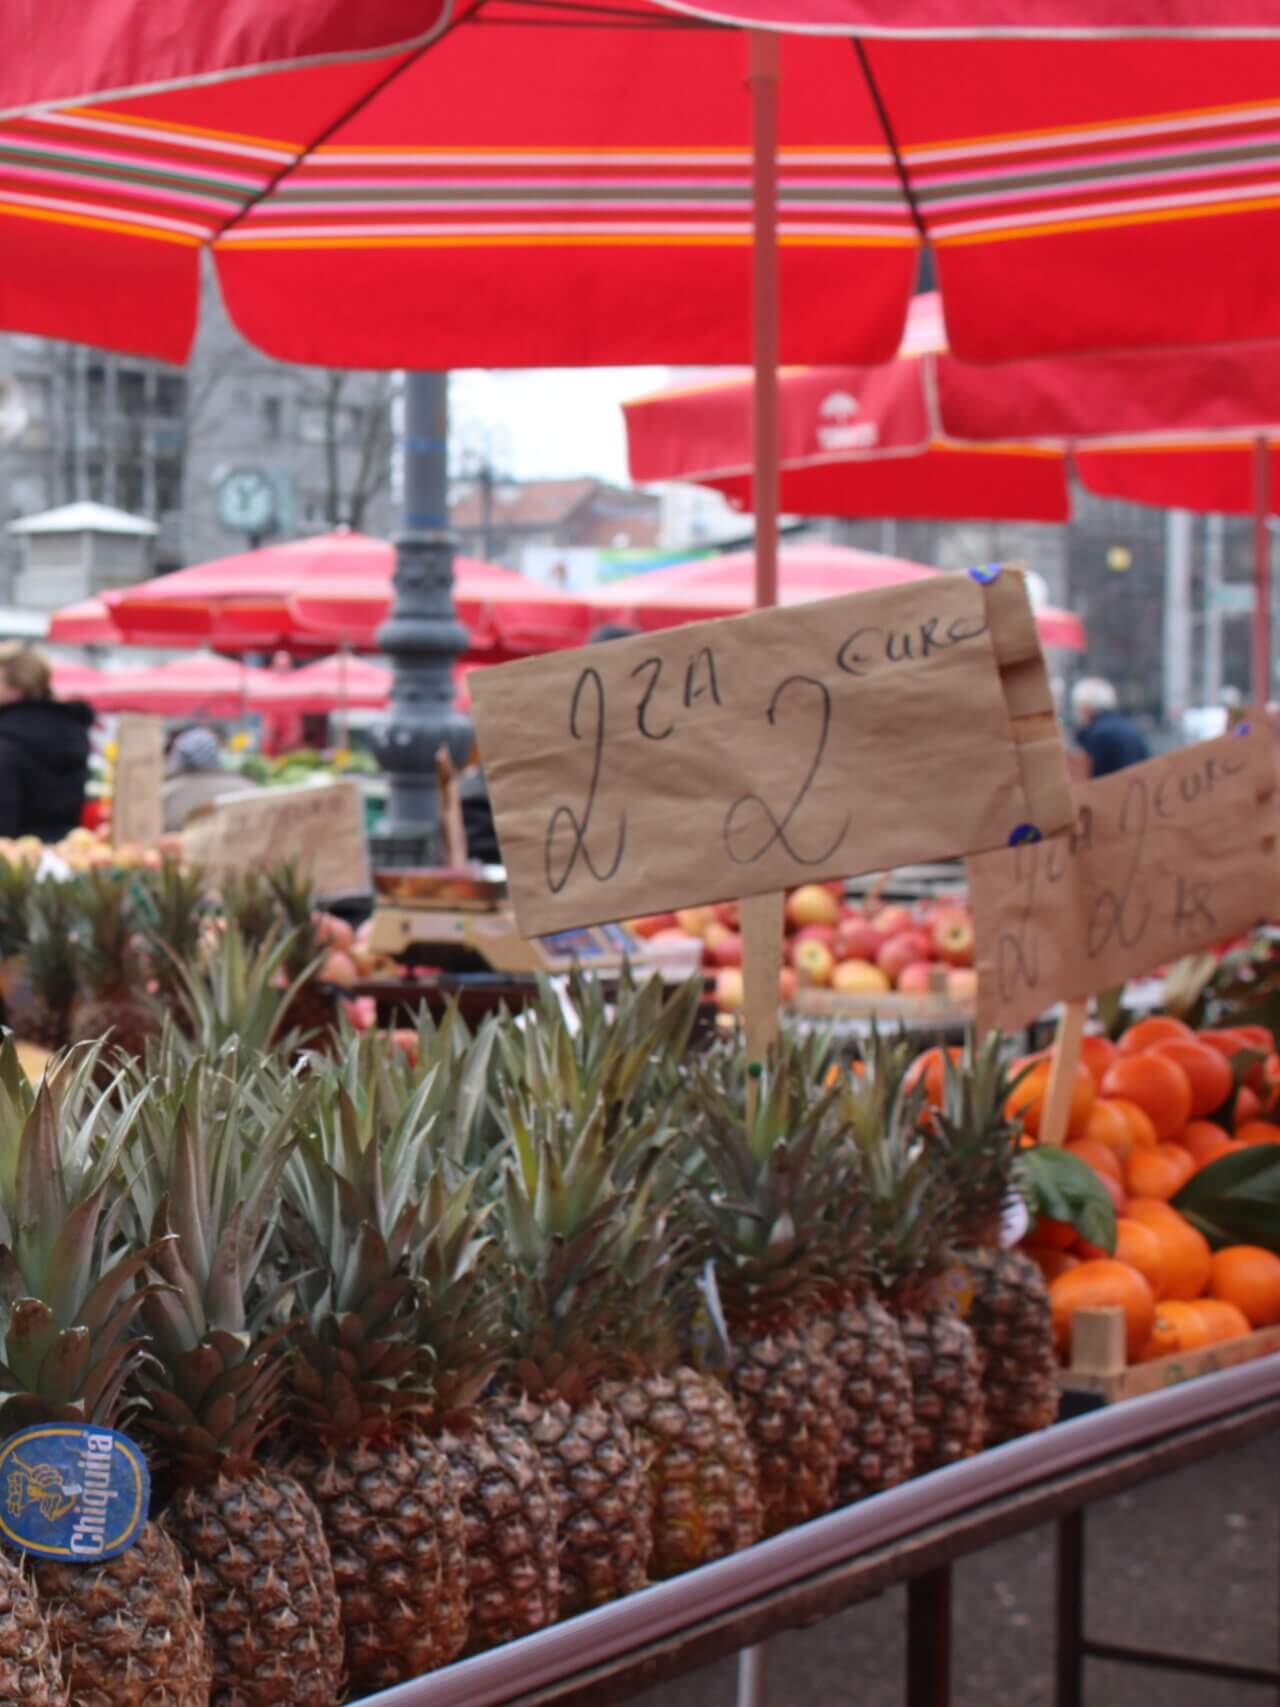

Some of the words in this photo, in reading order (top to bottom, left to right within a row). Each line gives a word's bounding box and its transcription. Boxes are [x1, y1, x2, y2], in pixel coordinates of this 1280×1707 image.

[546, 667, 627, 895] 2
[630, 646, 723, 741] ZA
[722, 674, 852, 867] 2
[70, 1433, 119, 1556] Chiquita
